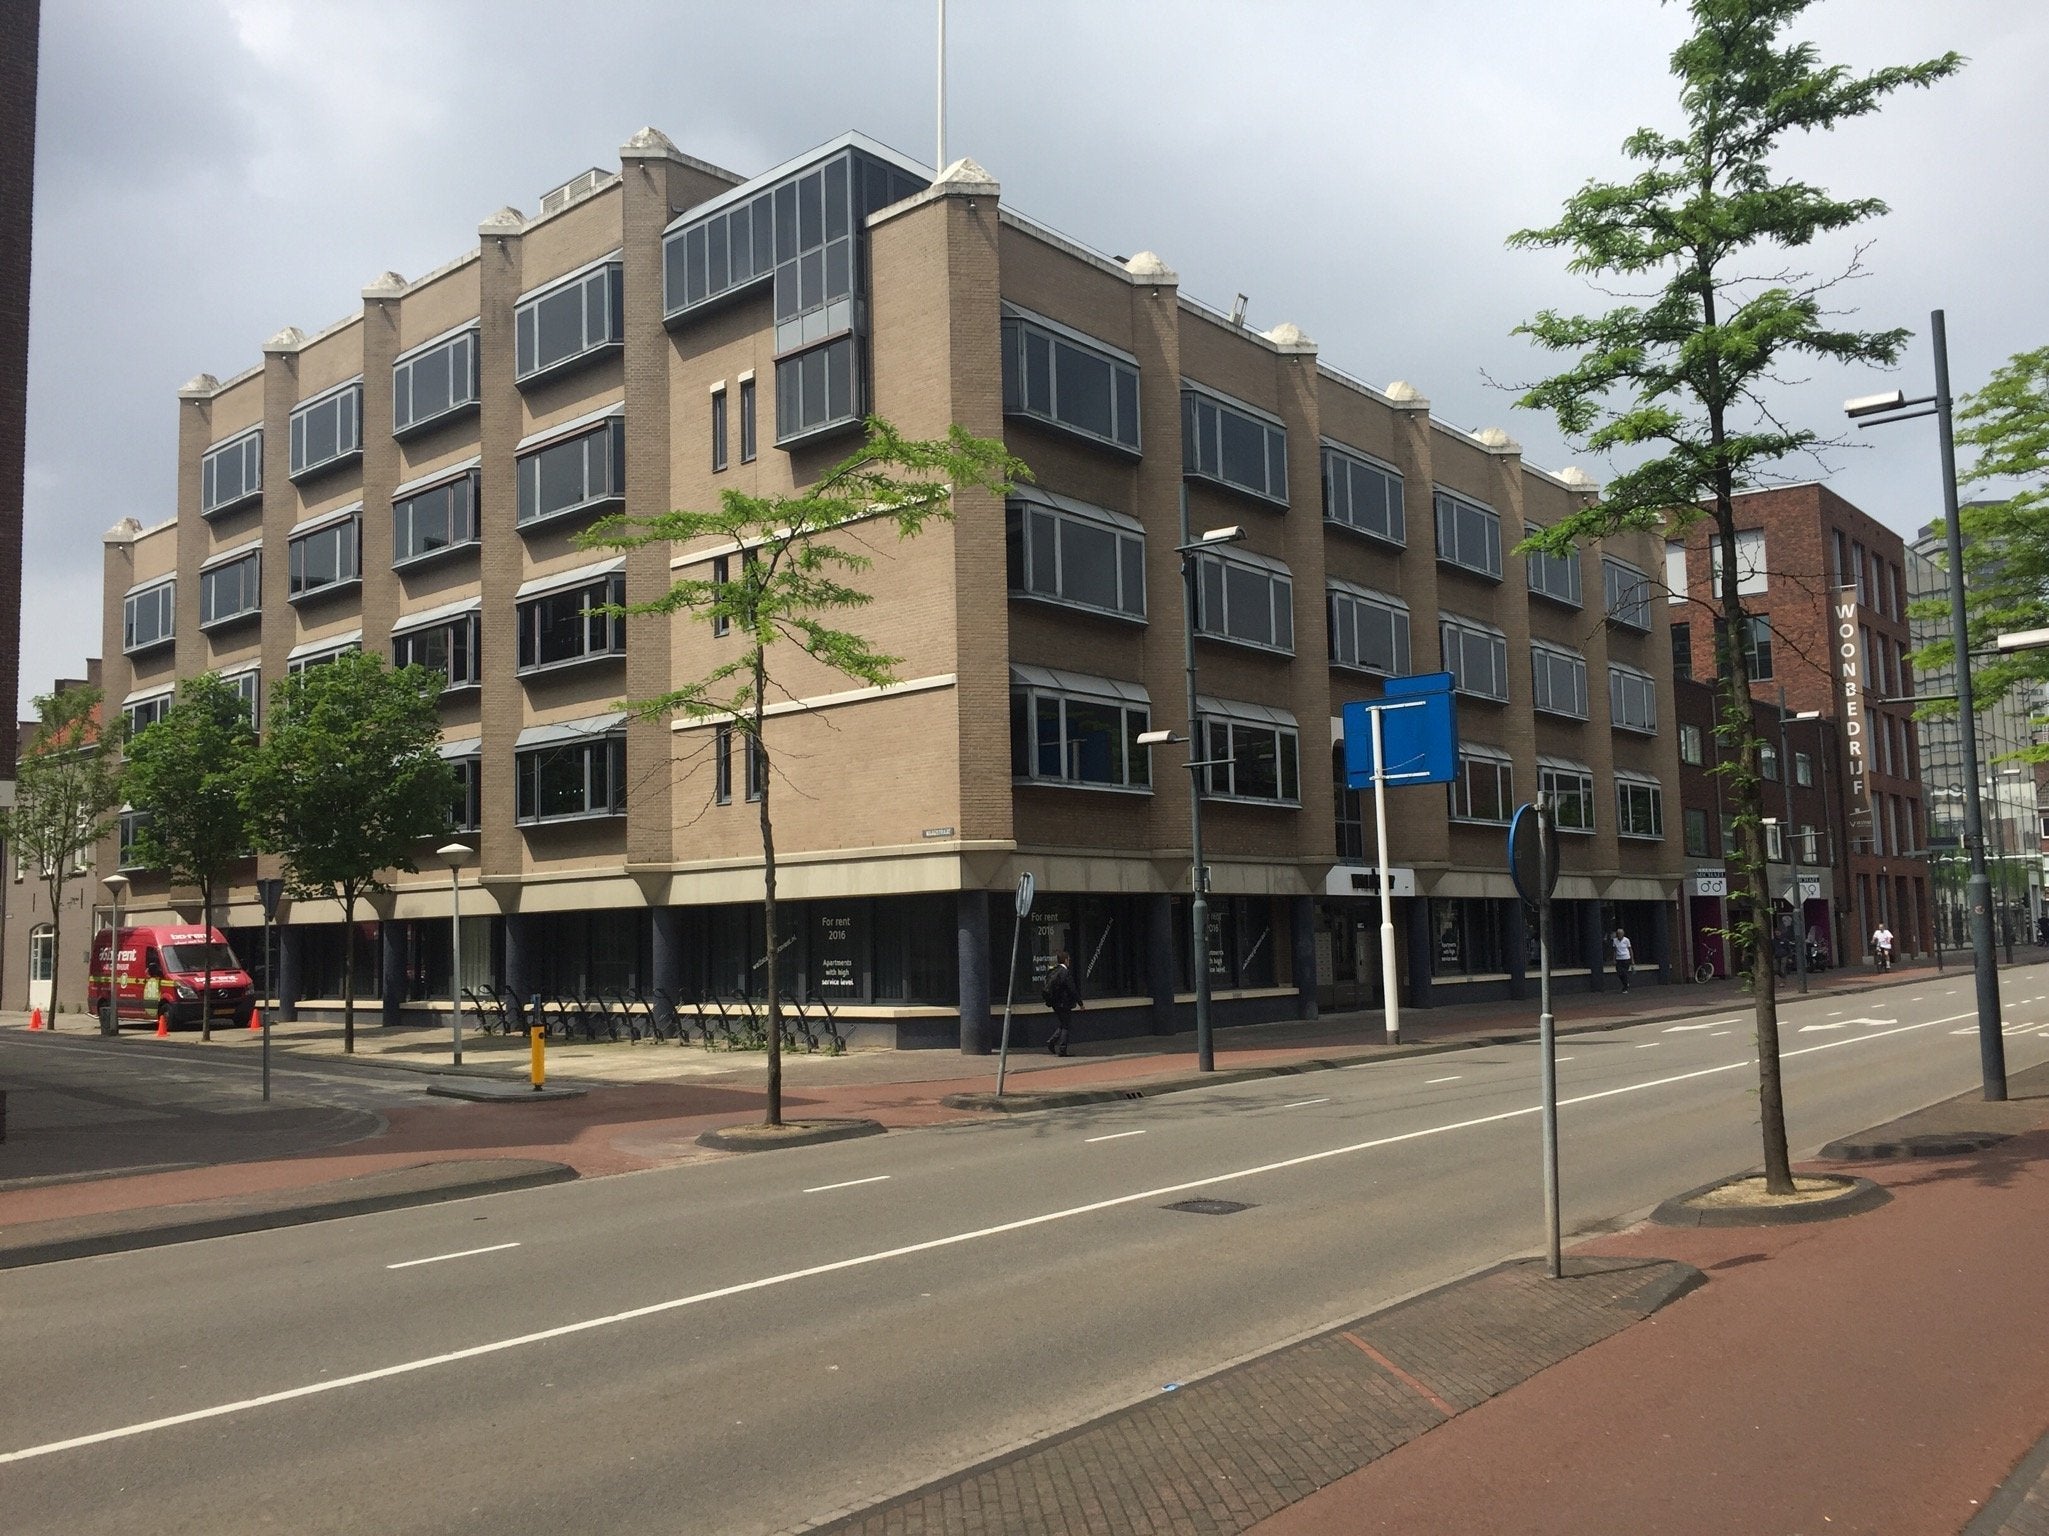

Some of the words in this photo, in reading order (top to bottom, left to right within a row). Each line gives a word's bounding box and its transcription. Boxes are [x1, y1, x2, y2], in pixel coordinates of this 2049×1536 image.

[1835, 603, 1863, 795] WOONBEDRIJF
[822, 917, 834, 927] For
[835, 917, 851, 927] rent
[828, 930, 846, 940] 2016
[822, 959, 852, 968] Apartments
